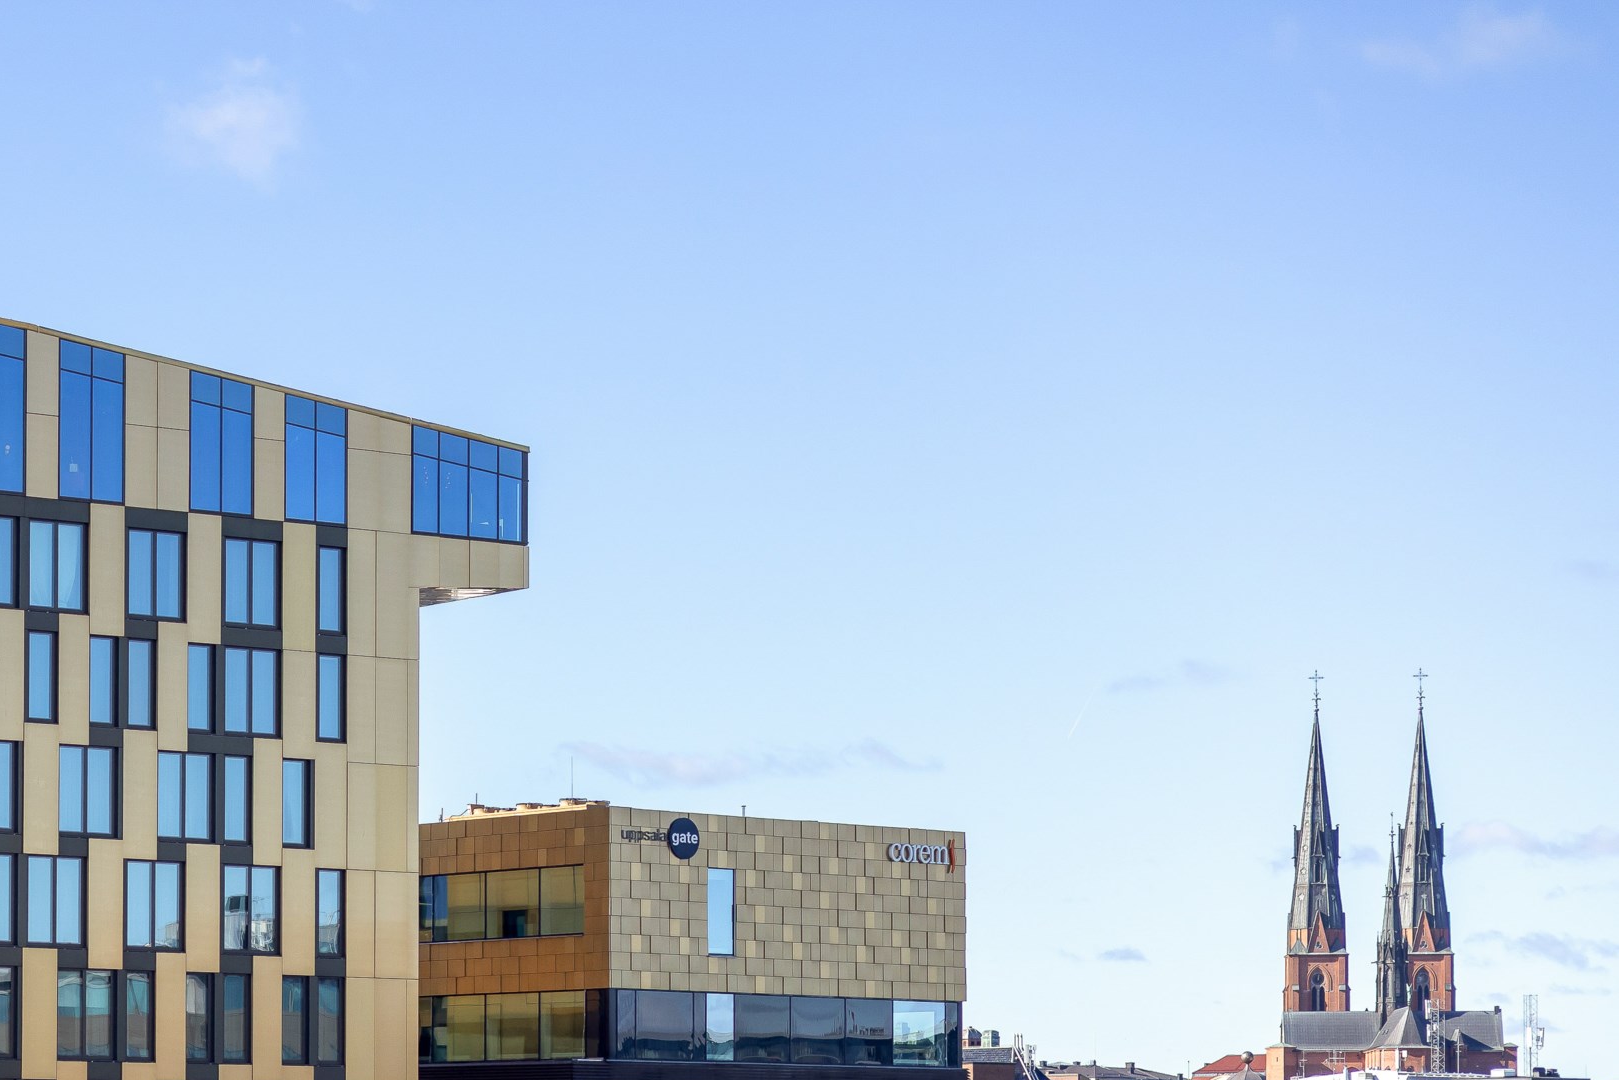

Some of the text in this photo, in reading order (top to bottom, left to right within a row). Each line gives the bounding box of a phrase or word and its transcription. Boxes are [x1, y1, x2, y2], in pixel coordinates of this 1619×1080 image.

[621, 828, 699, 846] uppsala gate
[888, 843, 950, 865] corem
